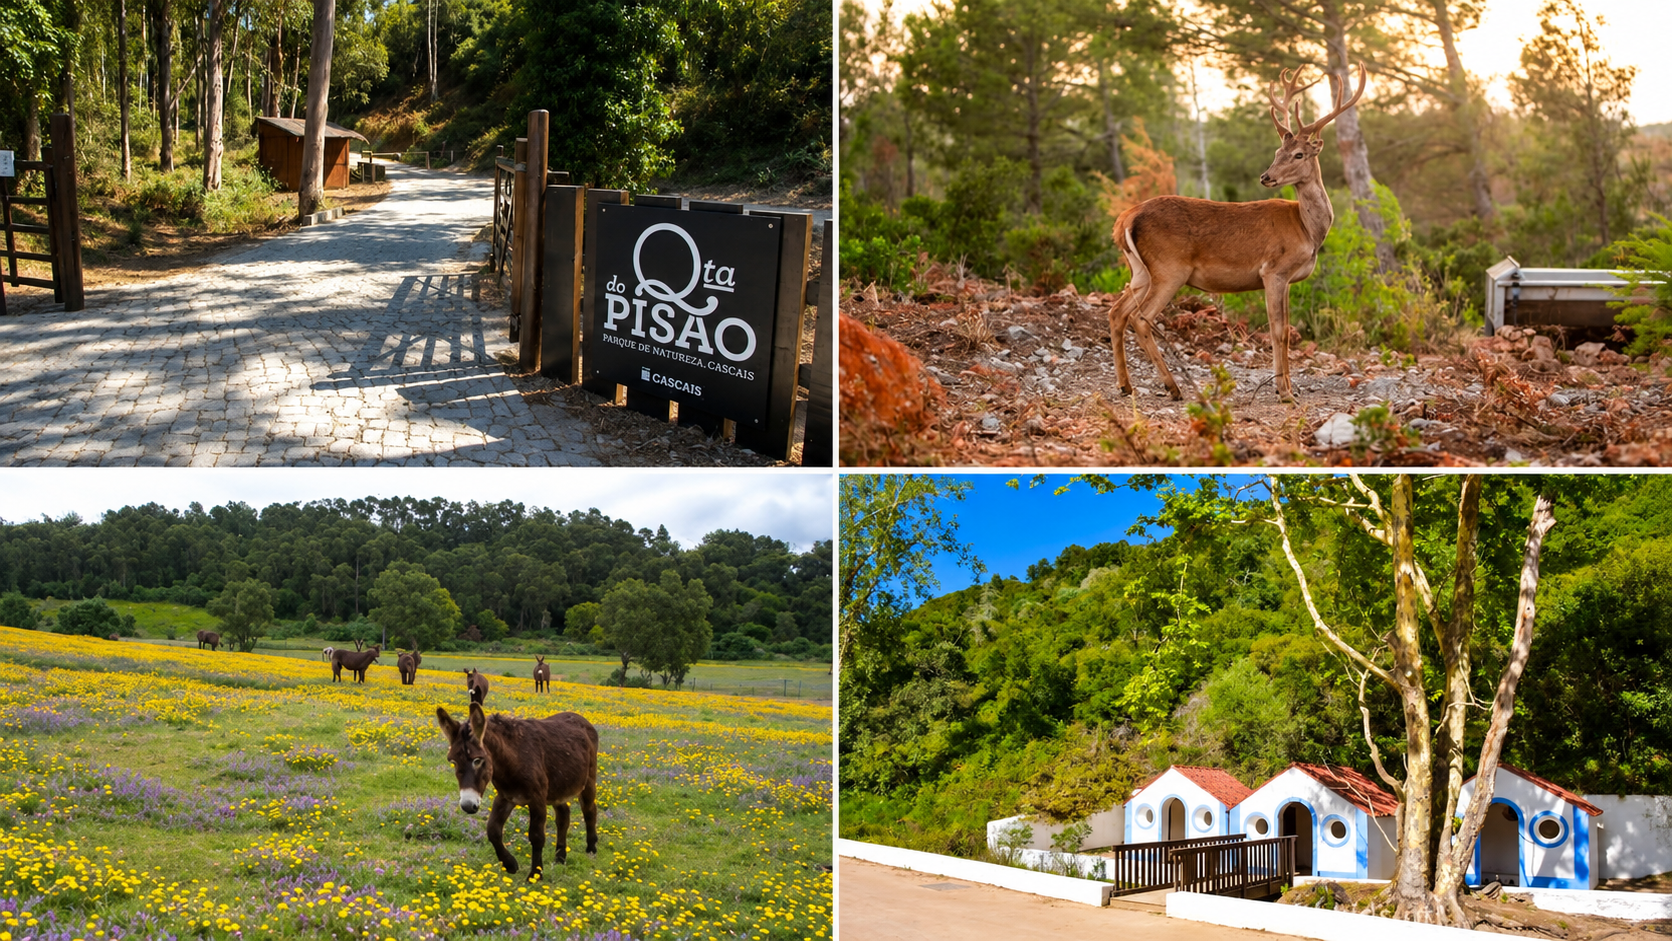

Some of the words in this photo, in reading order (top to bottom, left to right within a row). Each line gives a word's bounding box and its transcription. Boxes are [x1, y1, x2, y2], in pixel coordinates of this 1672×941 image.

[606, 275, 626, 294] do
[602, 333, 637, 349] PARQUE
[638, 344, 651, 353] DE
[707, 360, 755, 381] CASCAIS
[652, 373, 702, 396] CASCAIS
